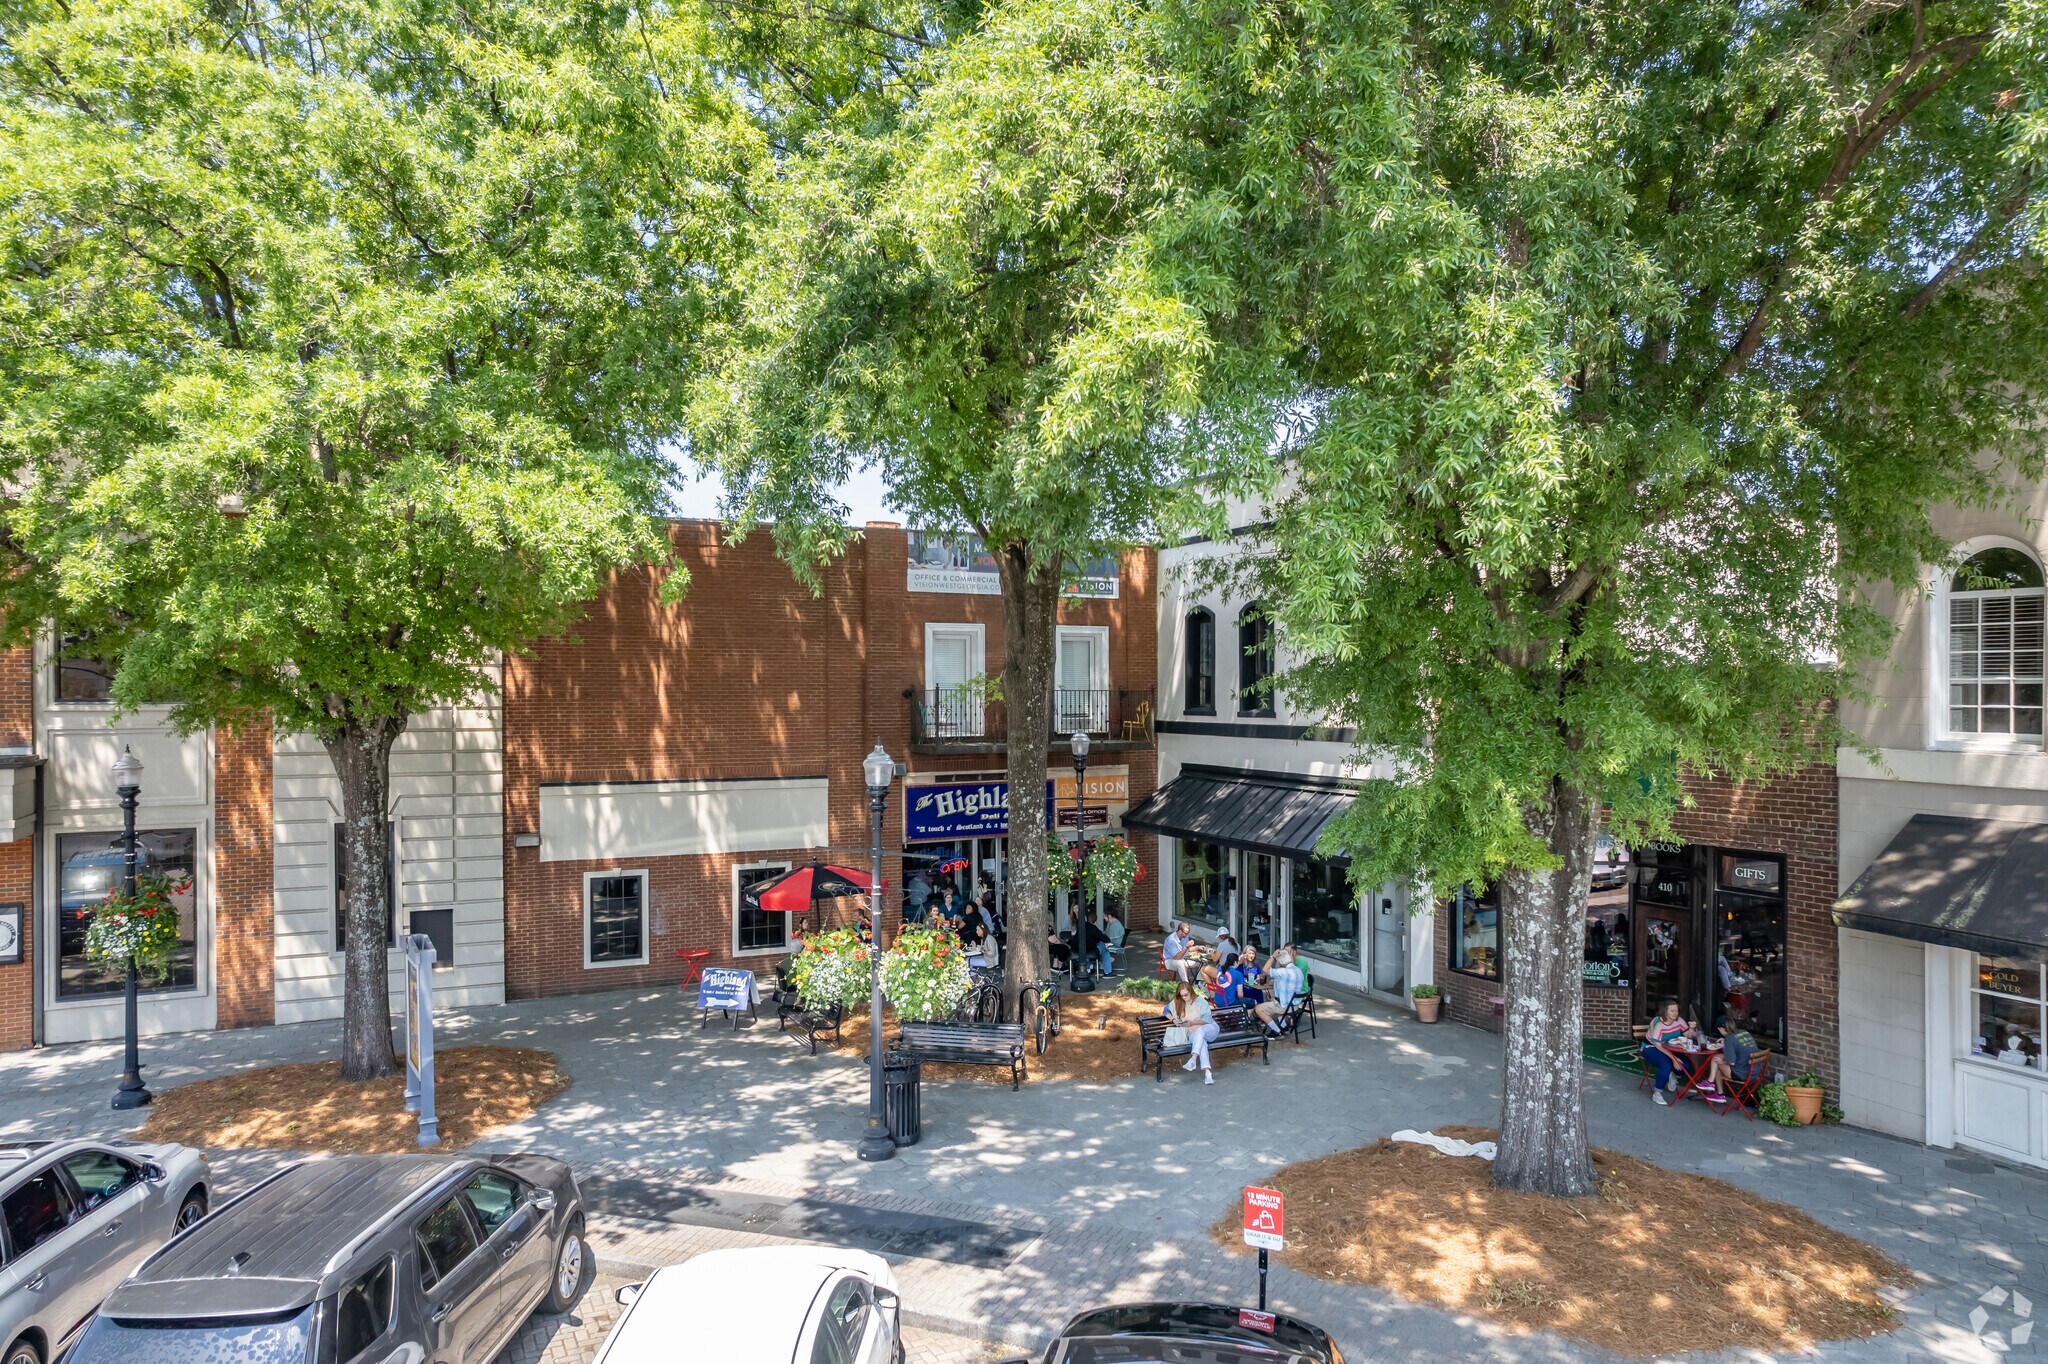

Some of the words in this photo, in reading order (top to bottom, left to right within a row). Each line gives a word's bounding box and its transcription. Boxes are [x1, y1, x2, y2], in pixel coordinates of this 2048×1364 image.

[914, 574, 940, 582] OFFICE
[950, 576, 997, 584] COMMERCIAL
[956, 823, 984, 831] Scotland
[1650, 842, 1681, 854] BOOKS
[941, 859, 969, 874] OPEN
[1735, 867, 1766, 880] GIFTS
[1658, 882, 1673, 892] 410
[710, 972, 748, 988] Highland
[1989, 970, 2019, 983] GOLD
[1989, 981, 2021, 994] BUYER
[1249, 1199, 1279, 1210] PARKING
[1255, 1193, 1281, 1204] MINUTE
